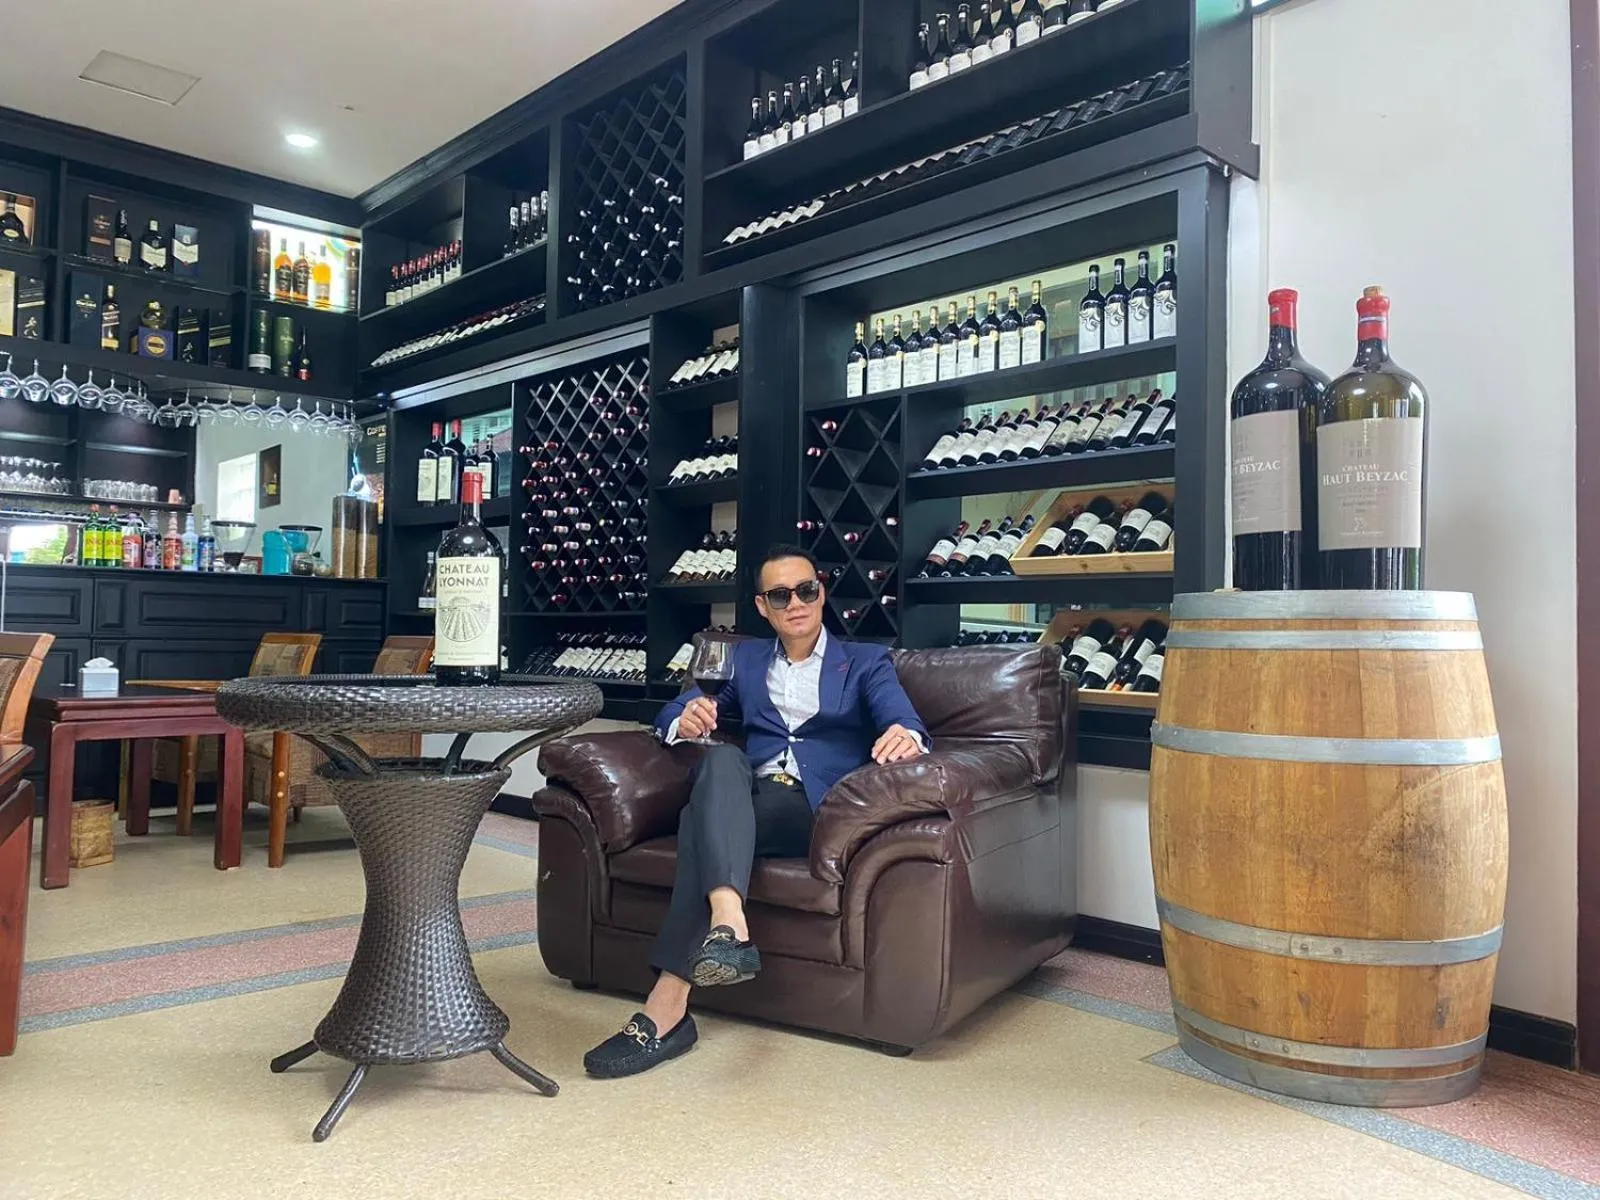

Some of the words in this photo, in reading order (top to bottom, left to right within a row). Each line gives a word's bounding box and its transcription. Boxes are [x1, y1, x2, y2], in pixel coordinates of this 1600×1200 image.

[1322, 473, 1352, 486] HAUT
[1356, 470, 1409, 482] BEYZAC
[439, 563, 490, 575] CHATEAU
